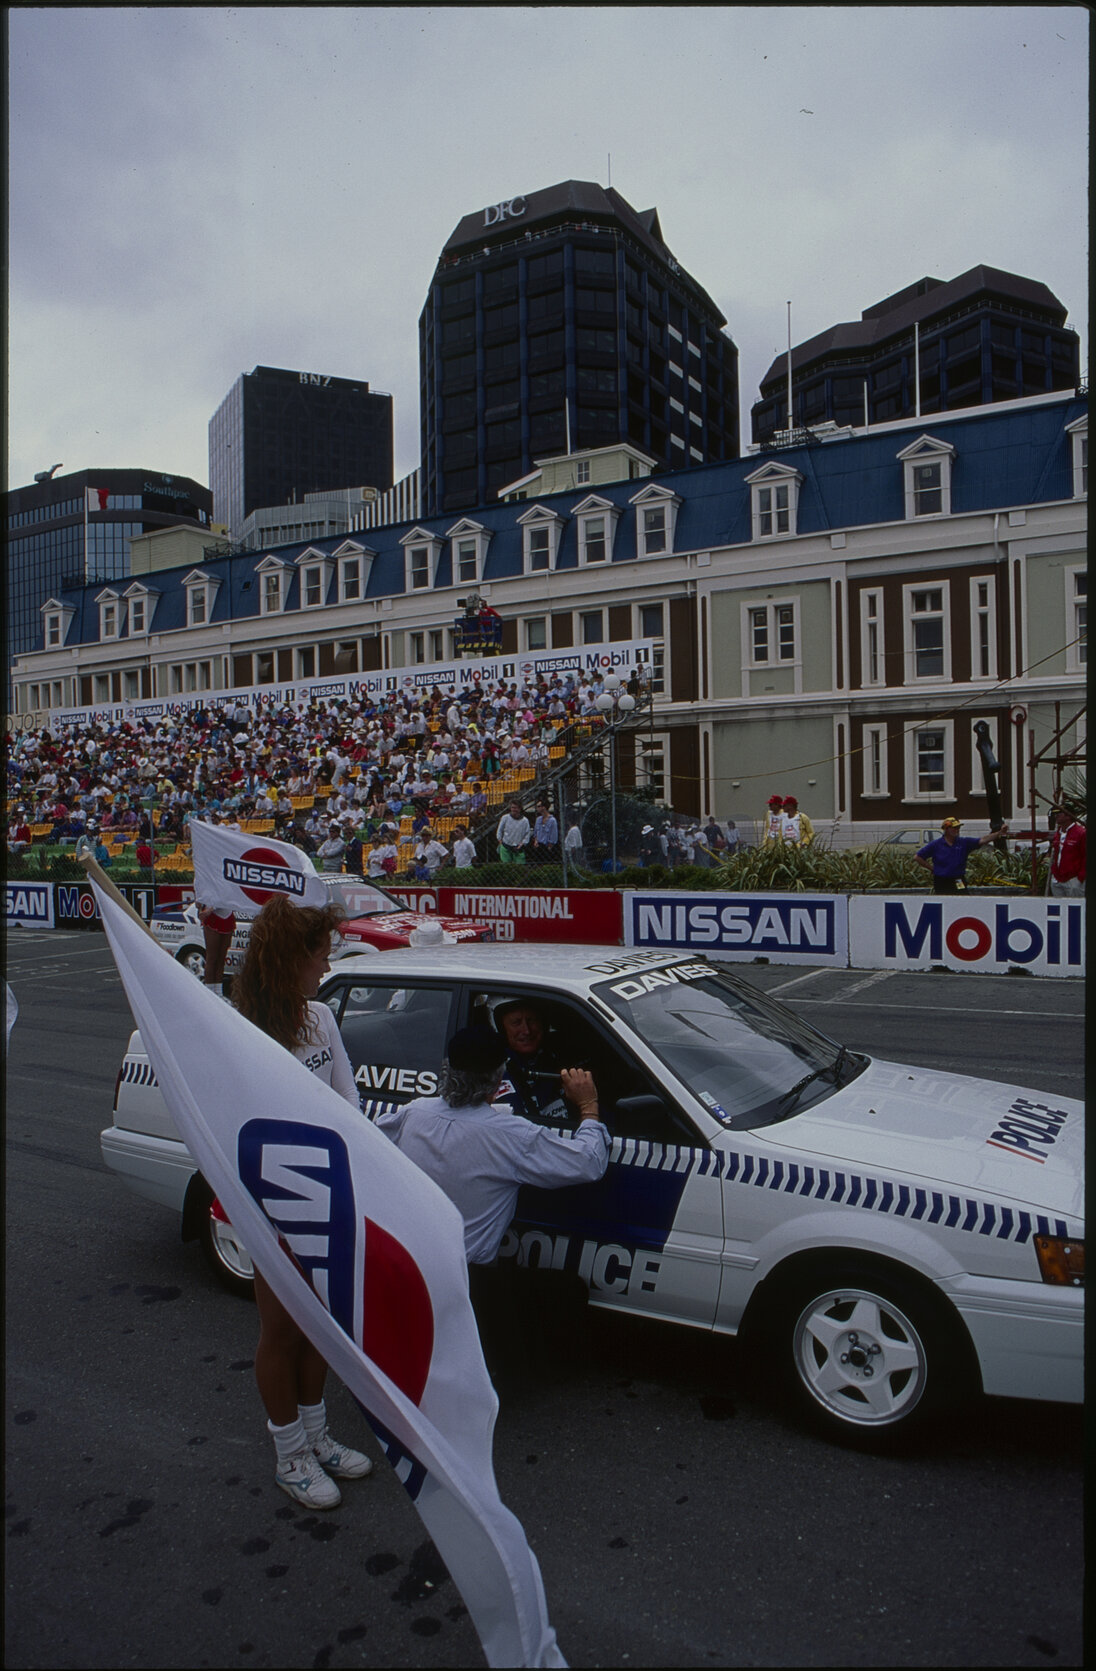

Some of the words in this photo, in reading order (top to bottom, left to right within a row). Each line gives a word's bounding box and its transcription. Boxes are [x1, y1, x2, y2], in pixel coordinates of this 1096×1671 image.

[482, 195, 526, 226] DFC
[299, 373, 333, 388] BNZ
[536, 657, 580, 673] NISSAN
[587, 650, 629, 668] Mobil
[415, 671, 455, 687] NISSAN
[460, 665, 498, 683] Mobil
[311, 684, 344, 697] NISSAN
[349, 678, 382, 694] Mobil
[252, 689, 281, 705] Mobil
[89, 710, 112, 722] Mobil
[136, 705, 162, 717] NISSAN
[166, 700, 192, 715] Mobil
[62, 713, 85, 724] NISSAN
[226, 862, 303, 892] NISSAN
[137, 891, 148, 919] 1
[454, 893, 574, 919] INTERNATIONAL
[638, 904, 828, 946] NISSAN
[885, 903, 1081, 965] Mobil
[584, 951, 679, 975] DAVIES
[610, 963, 719, 1001] DAVIES
[991, 1098, 1068, 1158] POLICE
